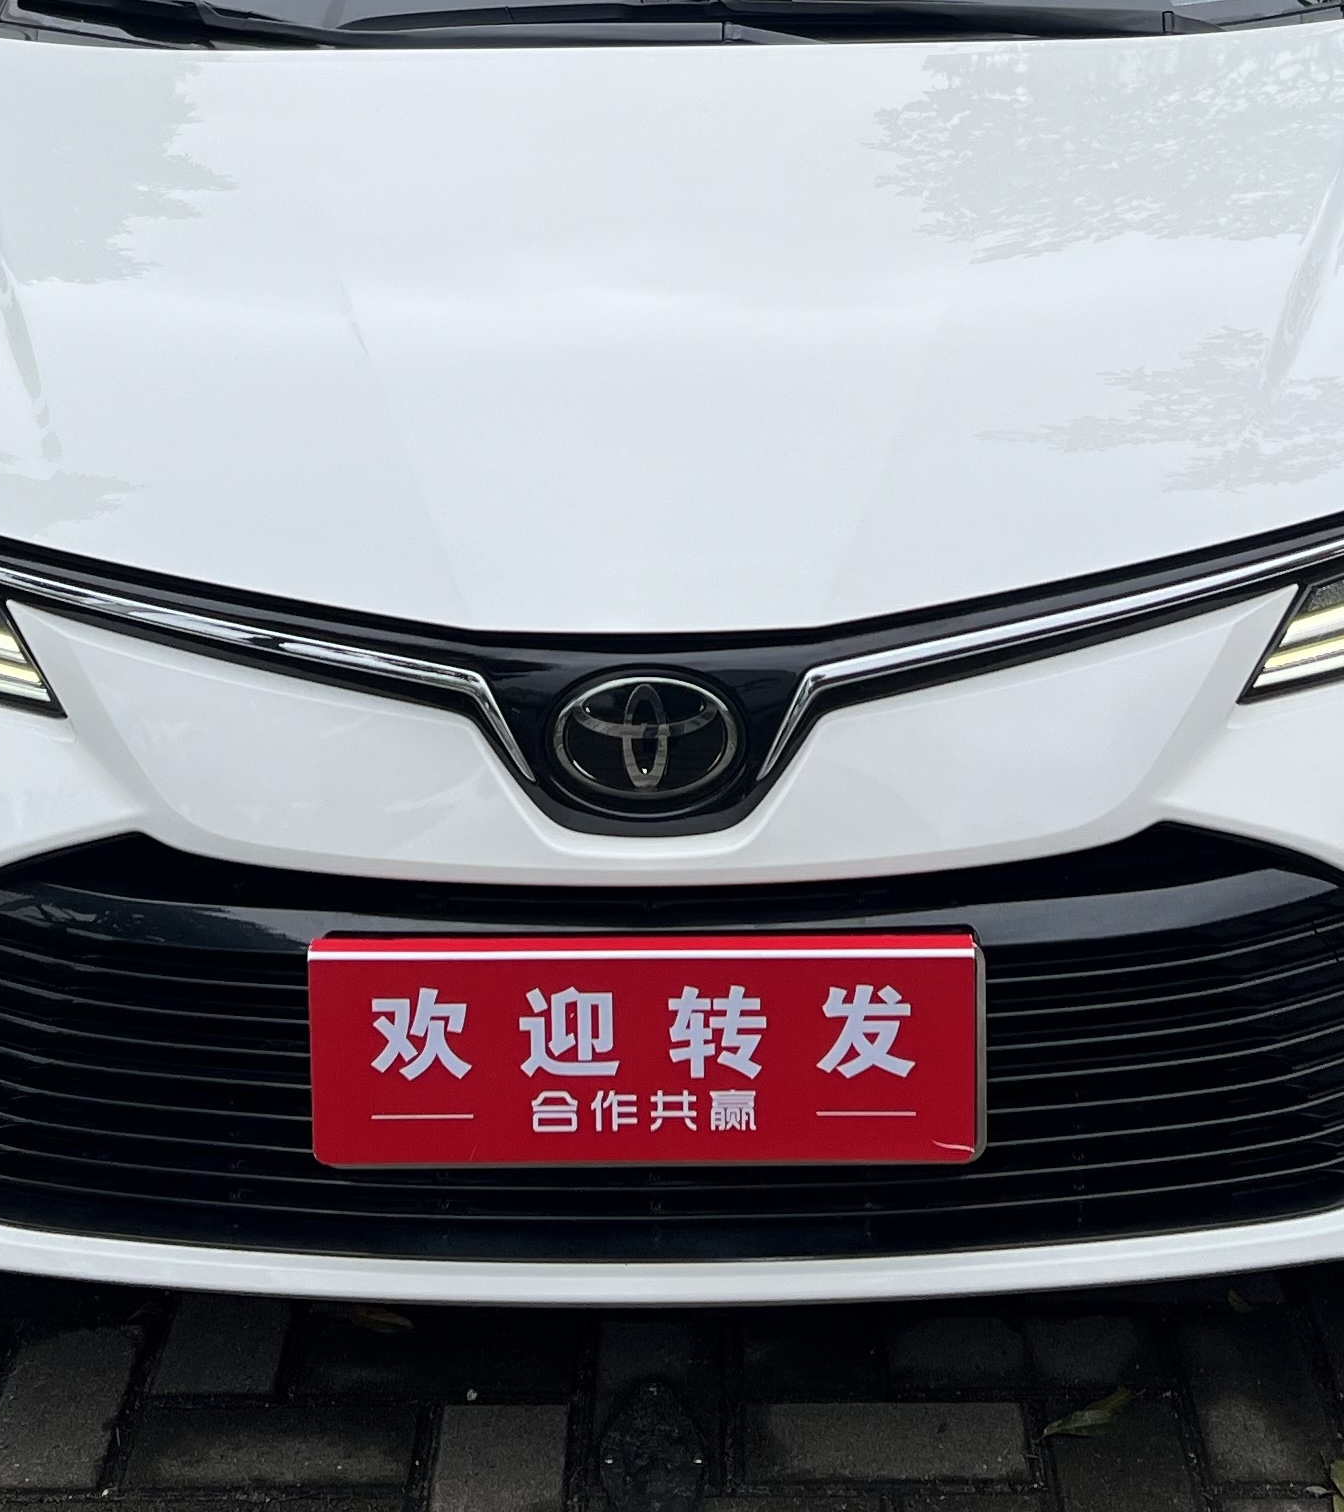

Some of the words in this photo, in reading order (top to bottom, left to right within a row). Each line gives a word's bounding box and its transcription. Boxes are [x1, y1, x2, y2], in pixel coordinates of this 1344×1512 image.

[370, 984, 916, 1081] 欢迎转发
[531, 1089, 758, 1133] 合作共赢
